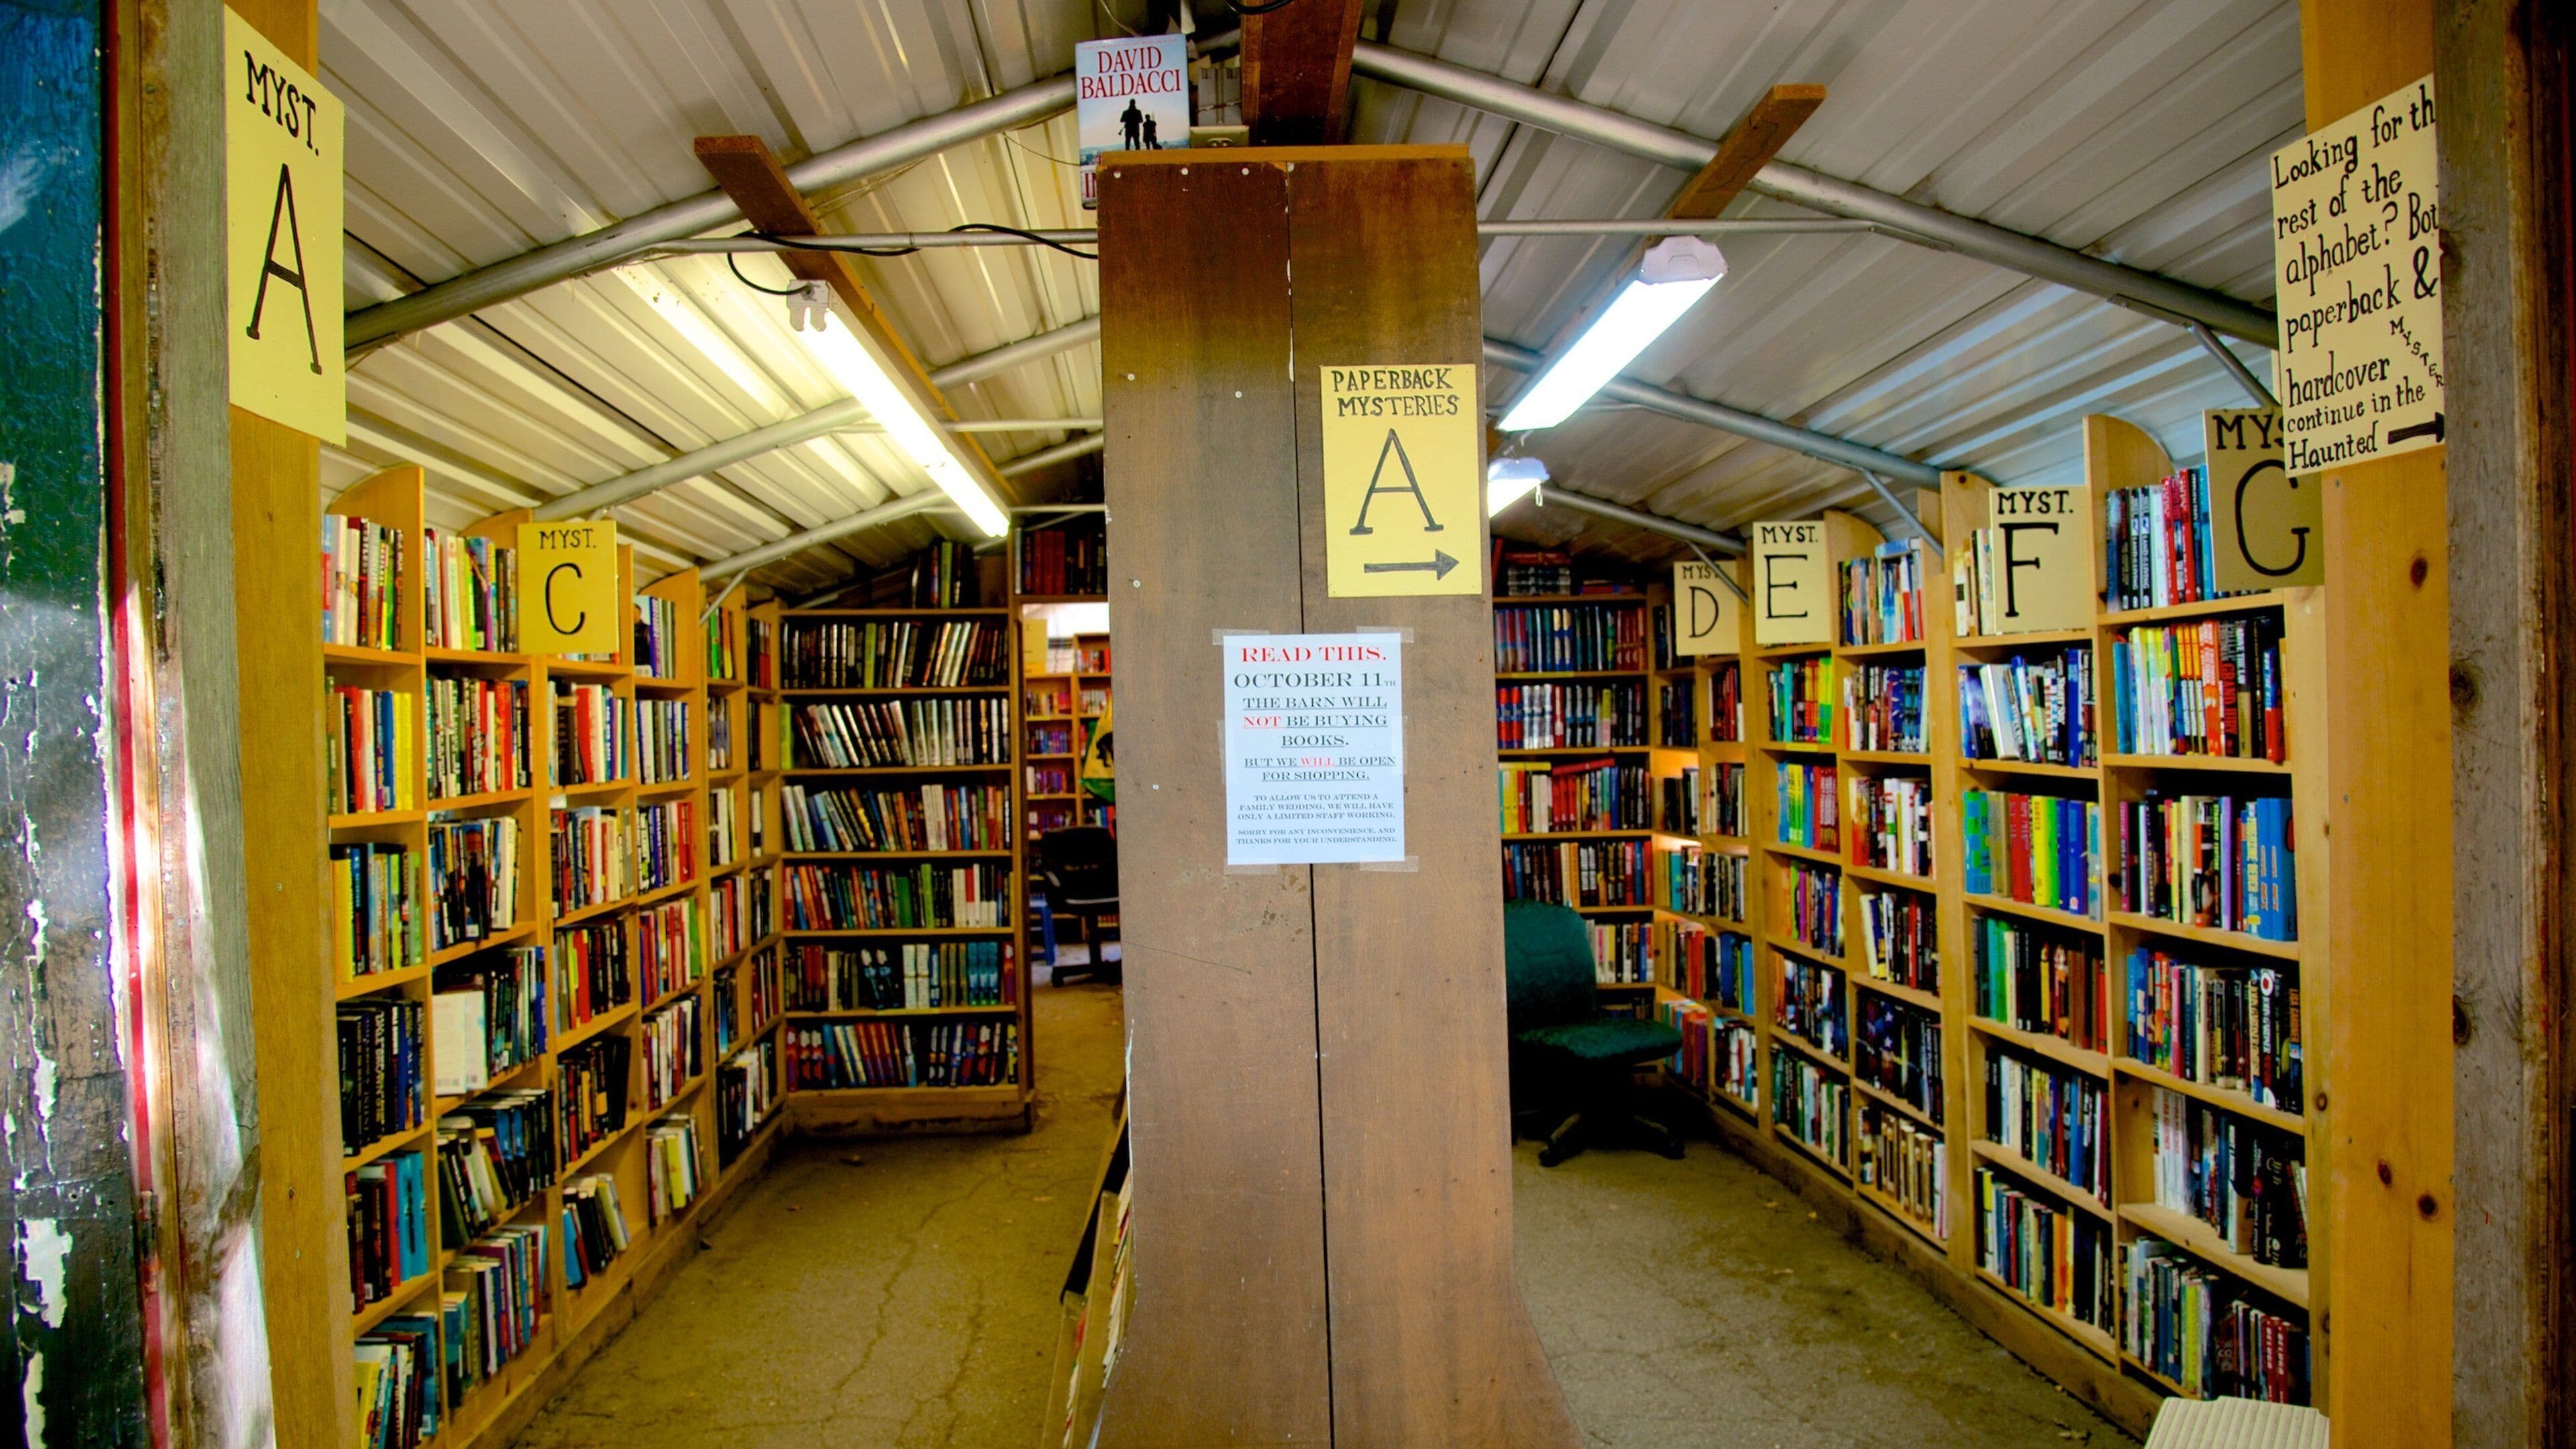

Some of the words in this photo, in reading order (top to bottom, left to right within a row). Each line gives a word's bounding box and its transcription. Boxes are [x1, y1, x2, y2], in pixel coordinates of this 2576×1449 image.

[1097, 46, 1162, 74] DAVID
[245, 50, 319, 156] MYST.
[1081, 69, 1181, 100] BALDACCI
[2273, 135, 2358, 189] Looking
[2371, 105, 2402, 148] for
[2277, 199, 2318, 239] rest
[2329, 173, 2349, 217] of
[2361, 162, 2403, 203] the
[246, 163, 323, 376] A
[2286, 201, 2398, 297] alphabet?
[2286, 264, 2402, 354] paperback
[2413, 246, 2438, 299] &
[1331, 368, 1454, 392] PAPERBACK
[2286, 350, 2390, 408] hardcover
[1338, 394, 1460, 417] MYSTERIES
[2288, 400, 2365, 433] continue
[2371, 393, 2391, 413] in
[2396, 376, 2426, 407] the
[2288, 420, 2379, 470] Haunted
[1349, 428, 1444, 535] A
[1998, 490, 2074, 515] MYST.
[539, 529, 596, 549] MYST.
[1761, 526, 1819, 543] MYST.
[2235, 459, 2310, 576] G
[1764, 554, 1808, 619] E
[1999, 522, 2059, 617] F
[545, 562, 586, 635] C
[1688, 586, 1719, 638] D
[1241, 647, 1311, 662] READ
[1319, 646, 1387, 661] THIS.
[1234, 672, 1352, 688] OCTOBER
[1243, 698, 1280, 708] THE
[1286, 697, 1335, 708] BARN
[1342, 696, 1387, 707] WILL
[2222, 663, 2235, 704] GRAND
[1244, 716, 1281, 727] NOT
[1287, 716, 1309, 726] BE
[1315, 714, 1387, 726] BUYING
[1281, 735, 1348, 746] BOOKS.
[1244, 758, 1273, 767] BUT
[1277, 757, 1297, 766] WE
[1300, 757, 1335, 766] WILL
[1339, 757, 1356, 766] BE
[1359, 757, 1396, 765] OPEN
[1263, 772, 1291, 780] FOR
[1293, 771, 1370, 780] SHOPPING.
